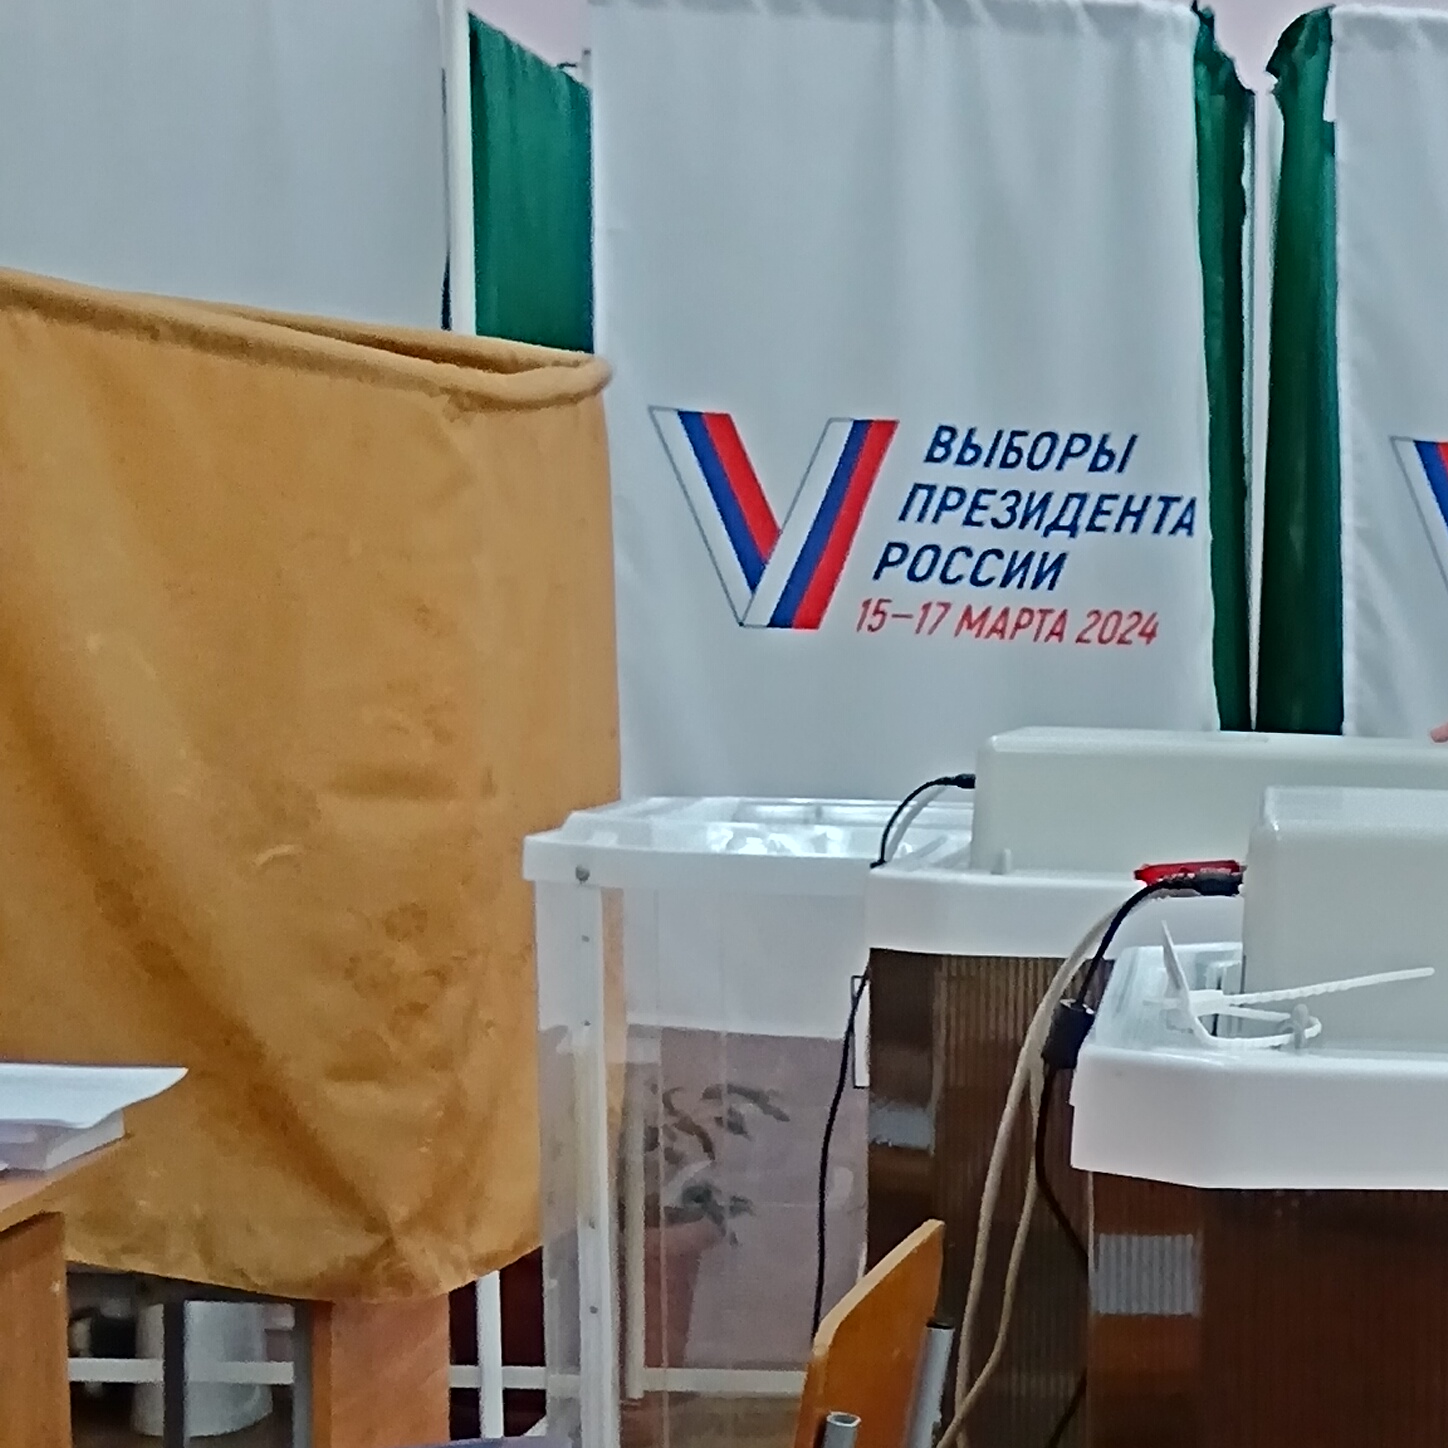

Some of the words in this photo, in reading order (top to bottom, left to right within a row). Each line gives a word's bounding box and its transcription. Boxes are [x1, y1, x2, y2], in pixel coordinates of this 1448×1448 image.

[923, 423, 1139, 474] ВЫБОРЫ
[897, 482, 1197, 540] ПРЕЗИДЕНТА
[871, 540, 1069, 592] РОССИИ
[954, 604, 1069, 643] МАРТА
[1075, 608, 1159, 646] 2024
